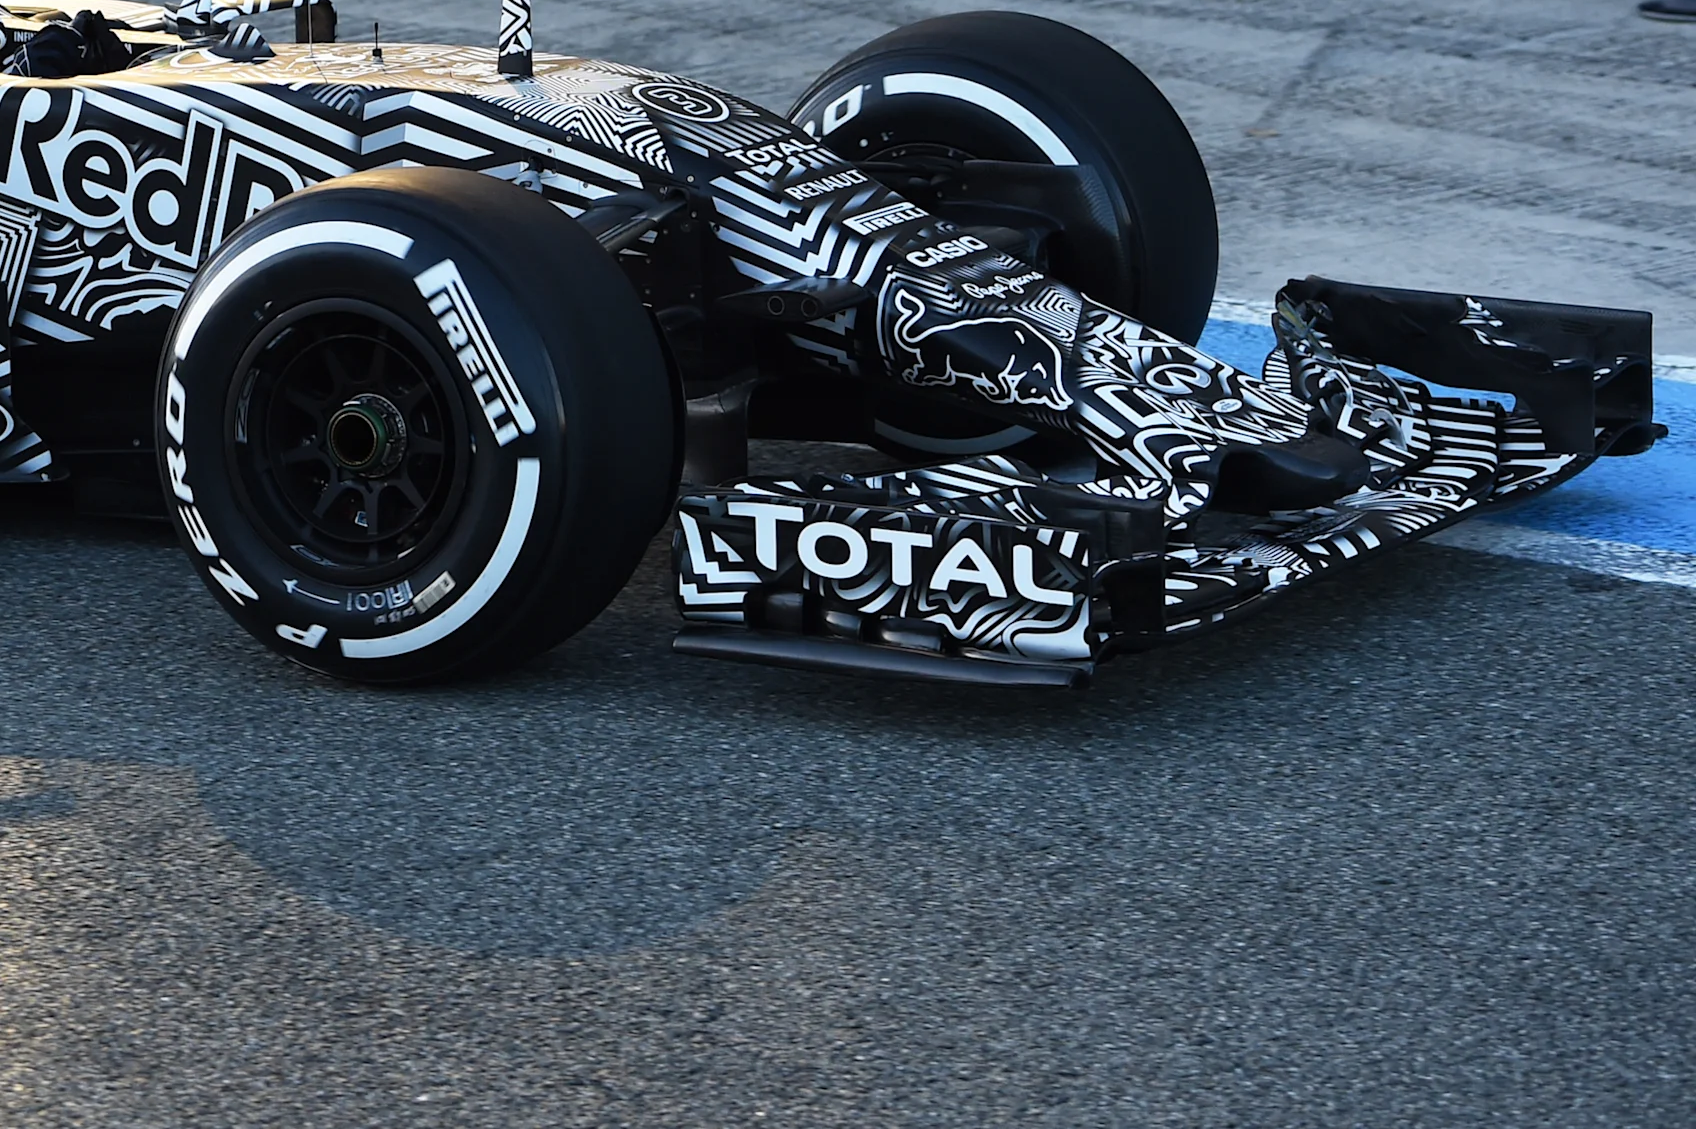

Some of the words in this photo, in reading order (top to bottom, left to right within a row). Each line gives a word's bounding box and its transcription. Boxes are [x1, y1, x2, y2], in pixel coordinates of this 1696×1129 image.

[724, 138, 820, 166] TOTAL
[784, 169, 869, 201] RENAULT
[842, 201, 930, 236] PIRELLI
[906, 235, 989, 268] CASIO
[961, 282, 1007, 300] Pepe
[993, 270, 1045, 294] Jeans
[413, 258, 536, 447] PIRELLI
[165, 370, 259, 607] ZERO
[727, 501, 1075, 607] TOTAL
[275, 623, 328, 649] P
